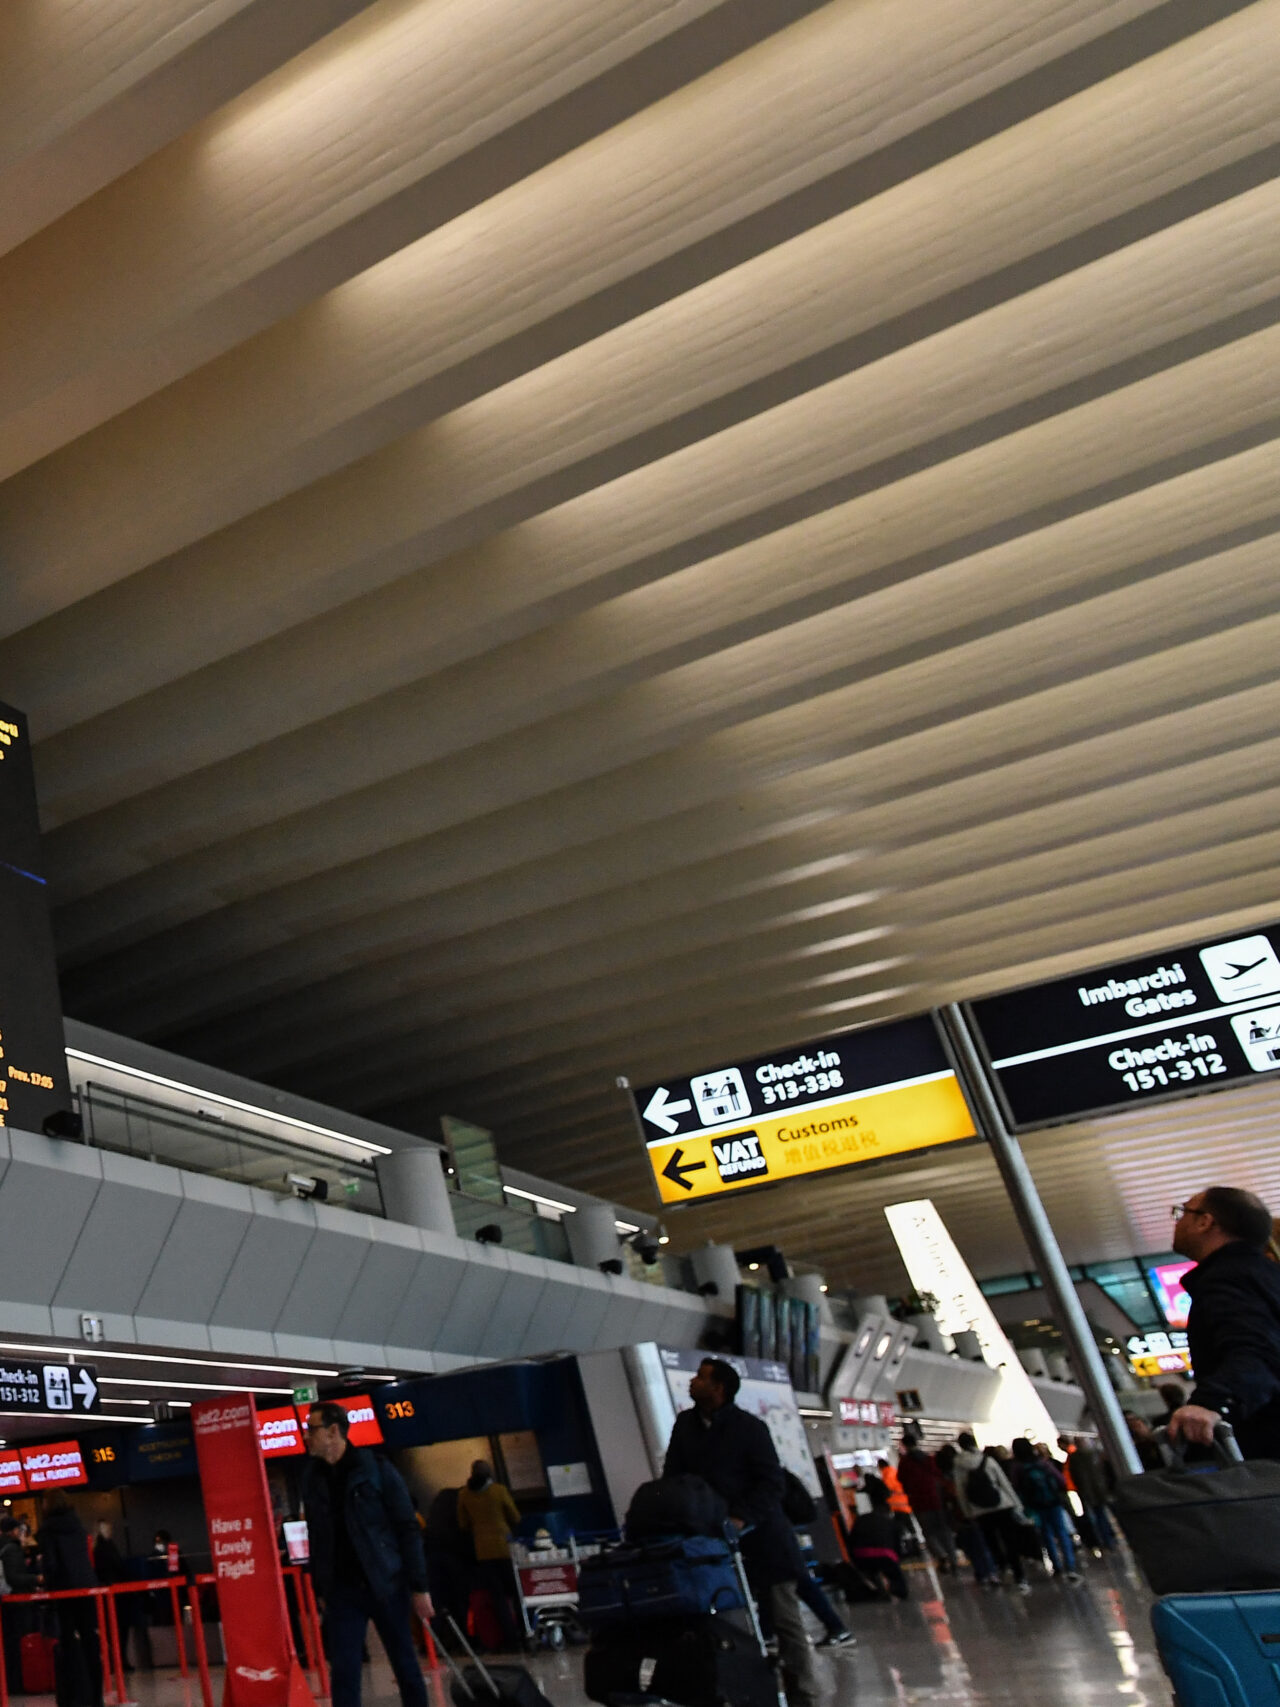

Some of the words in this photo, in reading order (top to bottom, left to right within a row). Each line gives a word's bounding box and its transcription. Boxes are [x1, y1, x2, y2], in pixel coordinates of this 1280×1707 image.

[1078, 963, 1187, 1006] Imbarchi
[1125, 989, 1197, 1017] Gates
[1108, 1033, 1217, 1070] Check-in
[756, 1051, 841, 1084] Check-in
[1122, 1054, 1227, 1092] 151-312
[761, 1070, 844, 1104] 313-338
[777, 1115, 859, 1142] Customs
[712, 1137, 759, 1164] VAT
[718, 1156, 766, 1177] REFUND
[0, 1387, 41, 1403] 151-312
[385, 1401, 415, 1419] 313
[24, 1452, 82, 1470] Jet2.com
[92, 1447, 116, 1463] 315
[211, 1518, 241, 1534] Have
[244, 1518, 252, 1530] a
[214, 1538, 252, 1556] Lovely
[218, 1559, 255, 1580] Flight!
